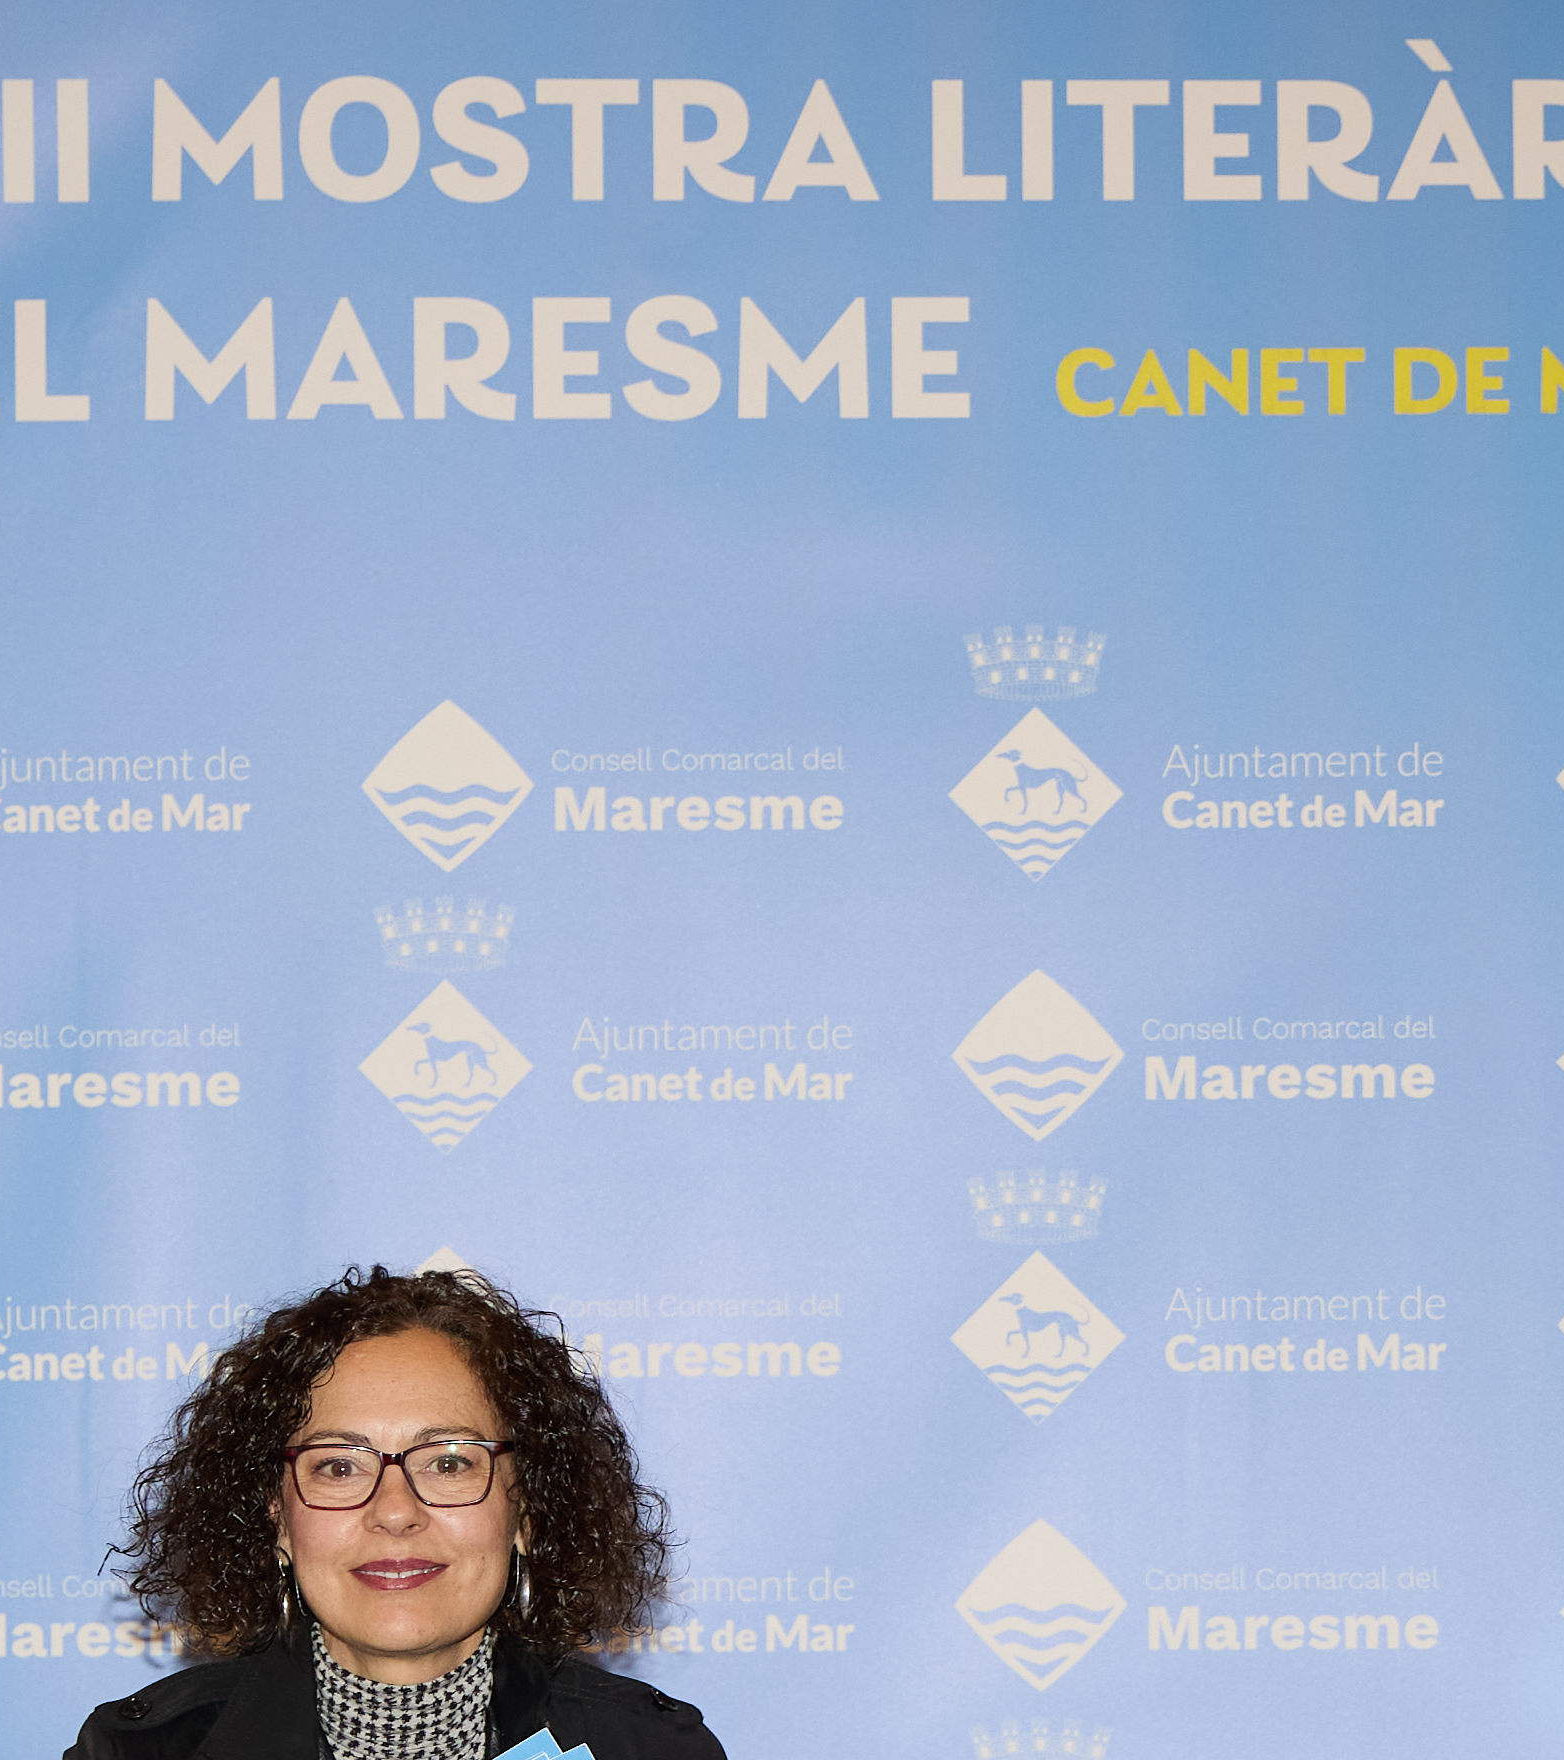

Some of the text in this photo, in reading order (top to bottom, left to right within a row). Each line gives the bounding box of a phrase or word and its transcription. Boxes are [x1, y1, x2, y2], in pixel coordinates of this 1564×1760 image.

[151, 75, 881, 203] MOSTRA
[144, 294, 970, 422] MARESME
[1055, 346, 1366, 418] CANET
[1393, 346, 1510, 415] DE
[204, 746, 250, 781] de
[107, 798, 154, 833] de
[161, 793, 252, 832] Mar
[1142, 1017, 1435, 1042] Consell Comarcal del
[1144, 1055, 1436, 1101] Maresme
[799, 1293, 843, 1318] del
[112, 1348, 157, 1381] de
[808, 1568, 854, 1602] de
[711, 1613, 855, 1653] de Mar
